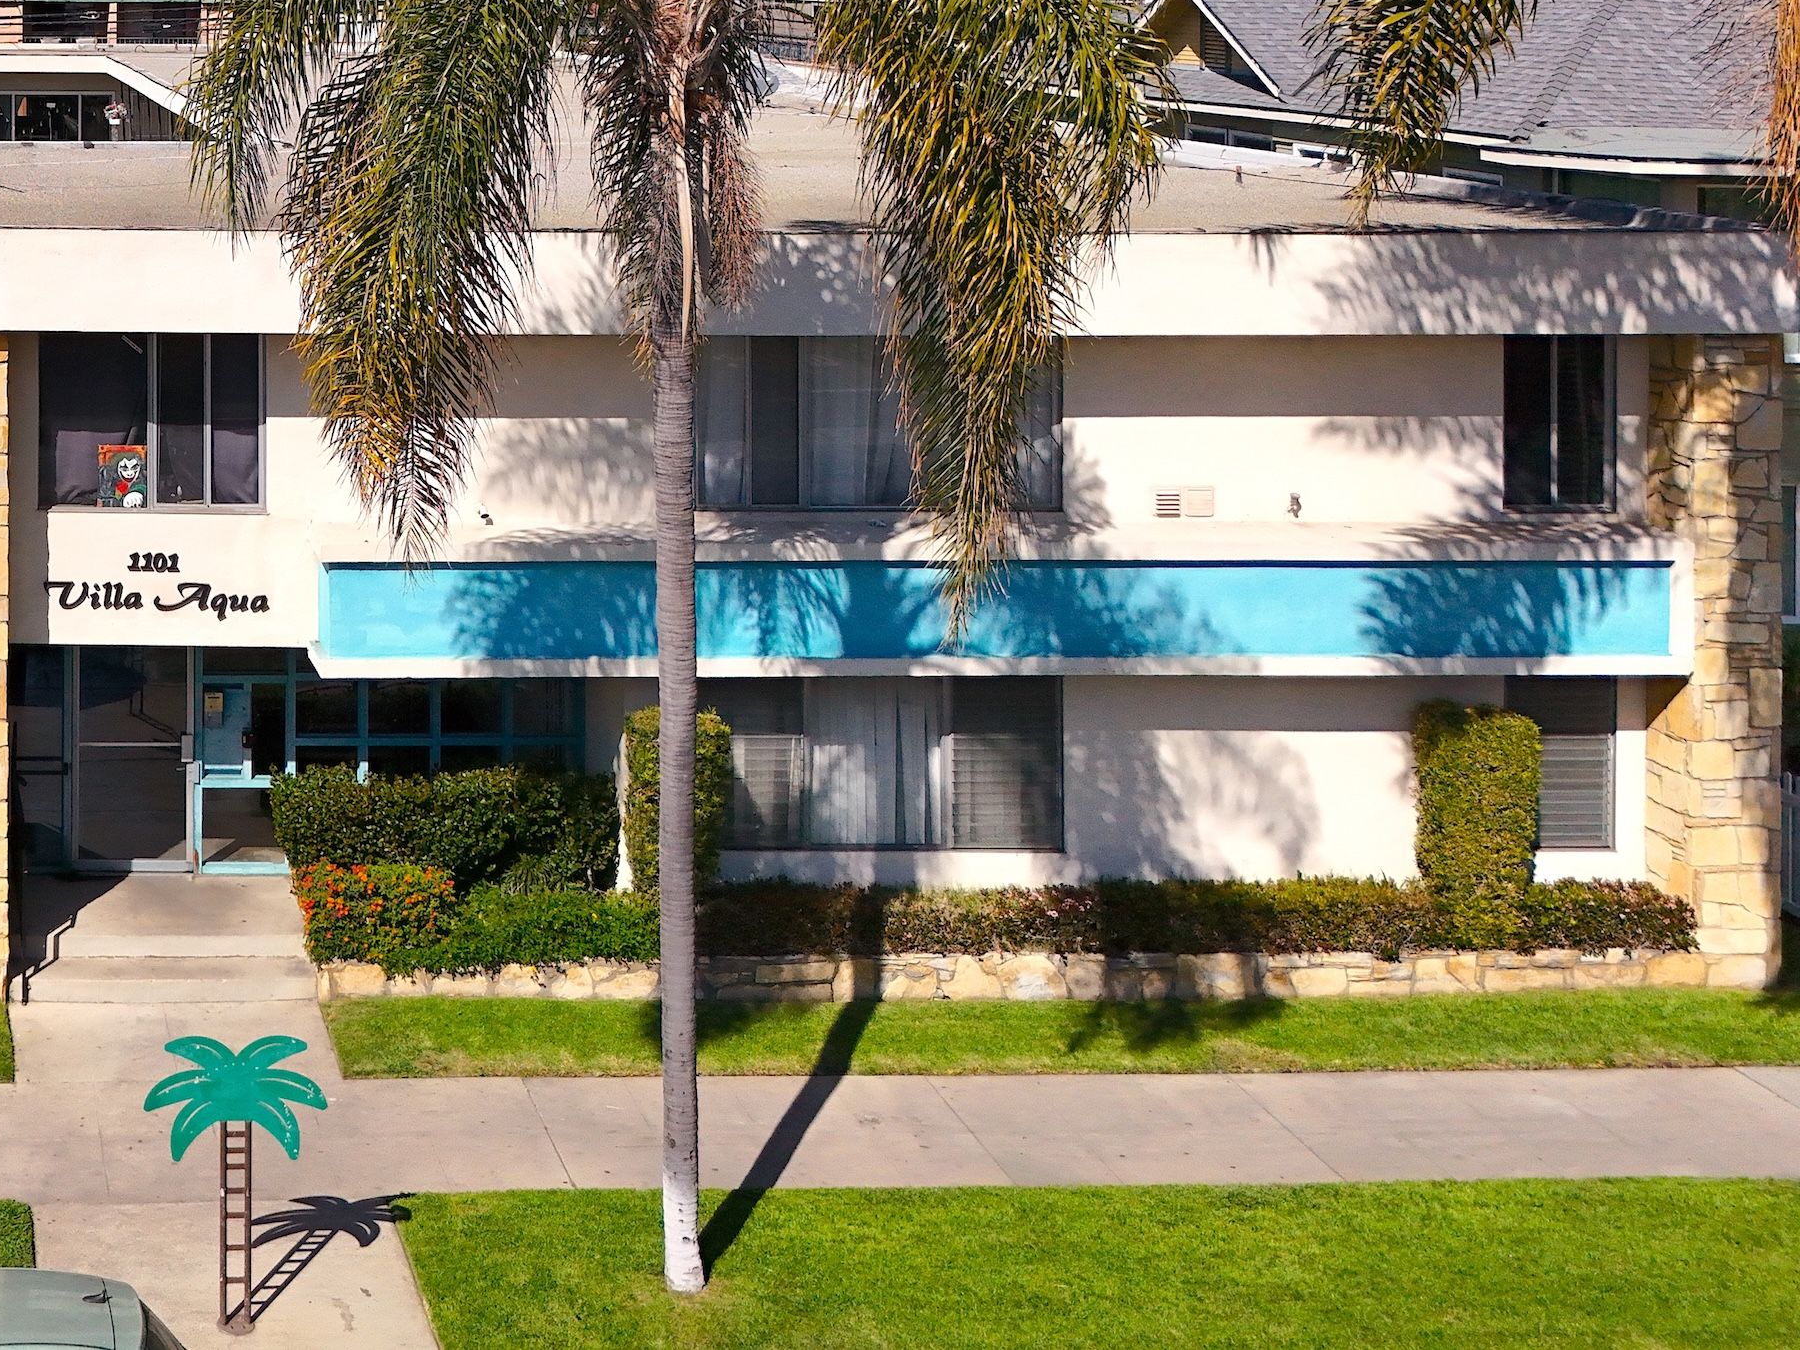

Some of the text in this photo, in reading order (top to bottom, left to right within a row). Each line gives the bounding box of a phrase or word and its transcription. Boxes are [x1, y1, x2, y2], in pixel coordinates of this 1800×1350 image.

[127, 552, 180, 573] 1101
[43, 581, 270, 621] Villa Aqua
